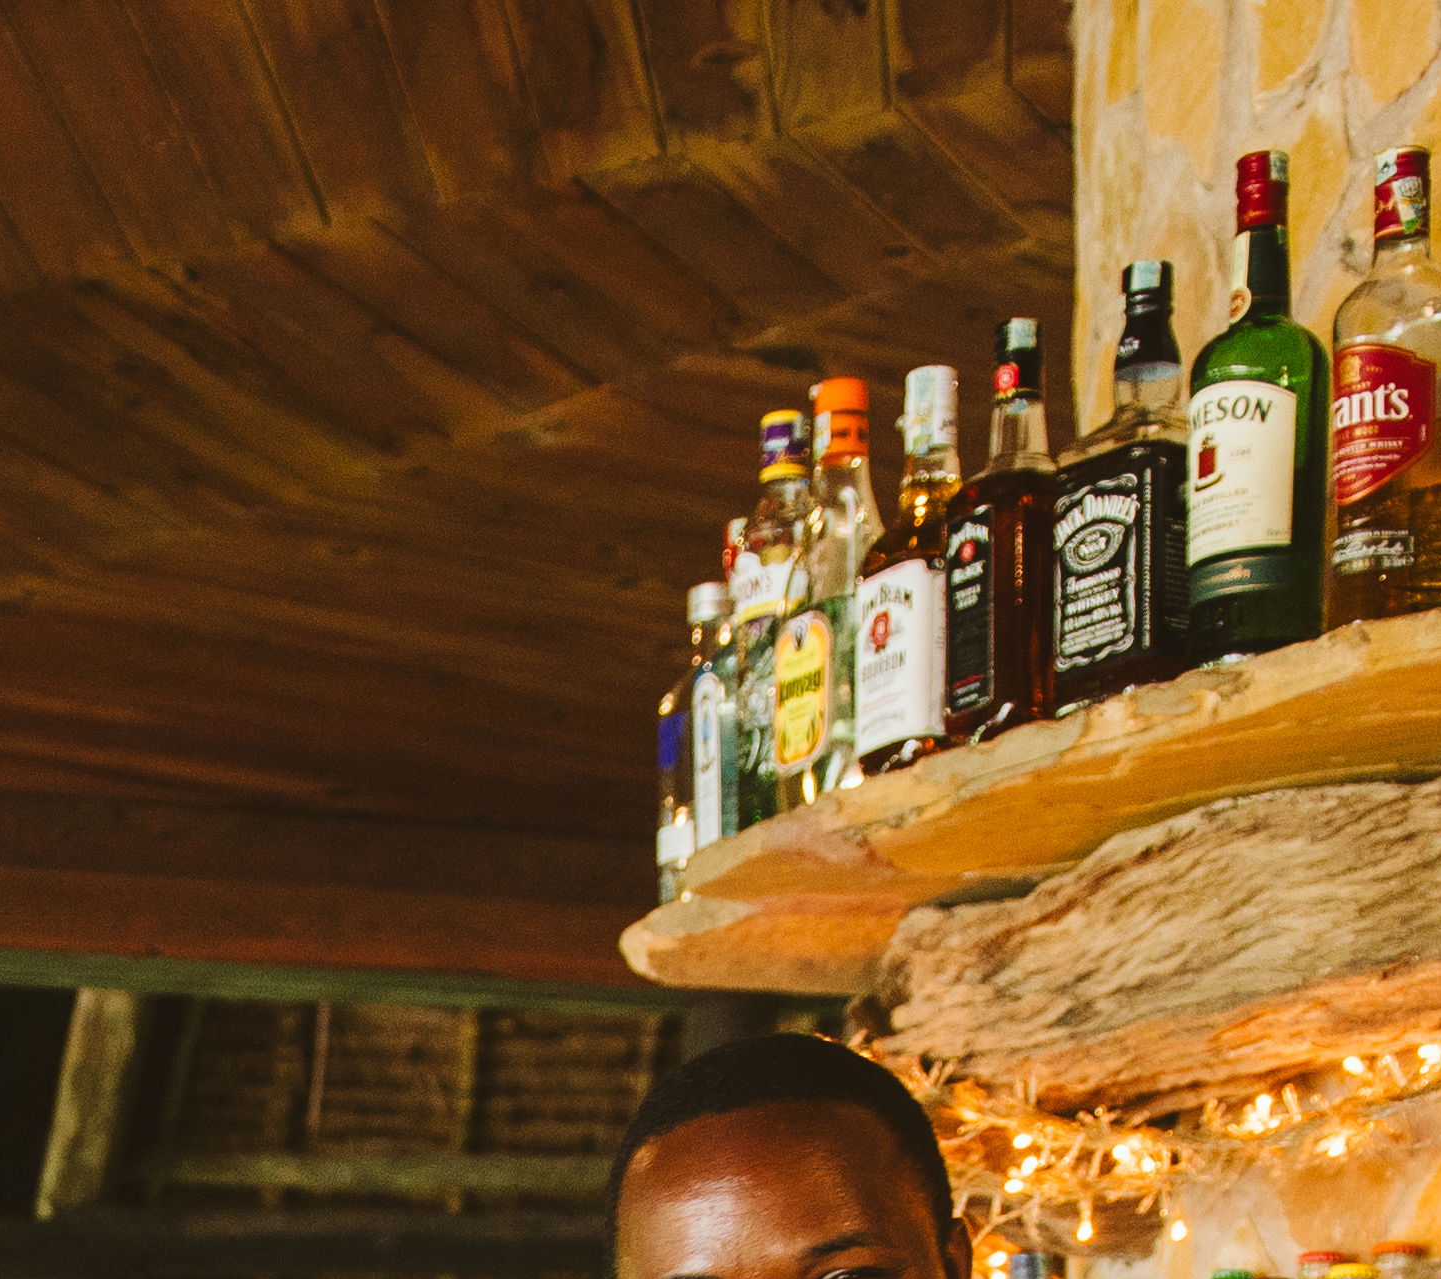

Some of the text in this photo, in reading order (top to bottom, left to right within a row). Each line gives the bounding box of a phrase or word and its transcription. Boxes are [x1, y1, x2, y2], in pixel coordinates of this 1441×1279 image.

[1192, 395, 1272, 431] MESON
[1332, 382, 1410, 430] ant's
[1053, 505, 1085, 550] JACK
[1082, 494, 1141, 525] DANIEL'S
